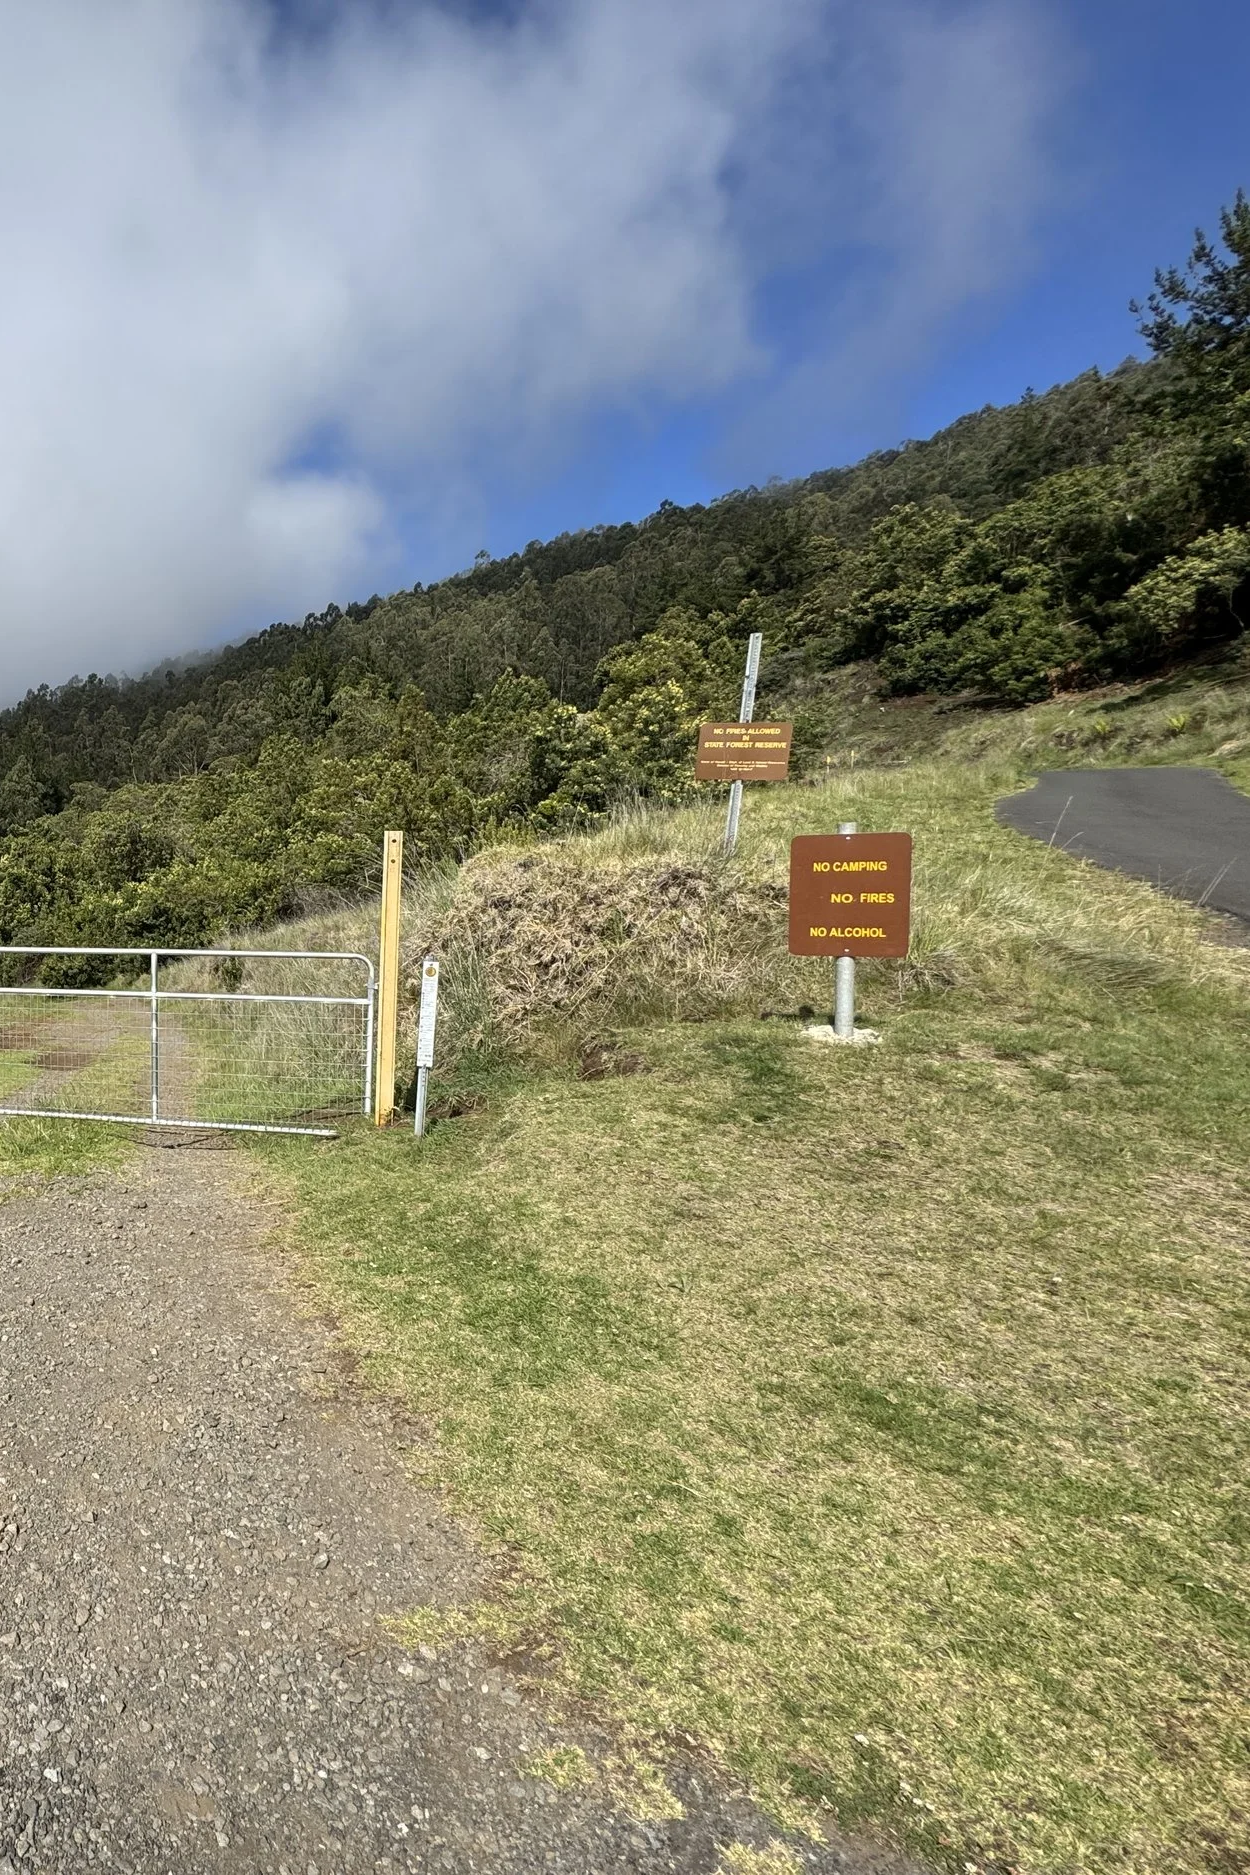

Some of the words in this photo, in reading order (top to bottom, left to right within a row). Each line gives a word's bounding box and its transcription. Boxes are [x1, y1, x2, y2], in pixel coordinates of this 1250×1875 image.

[813, 862, 830, 871] NO
[833, 861, 887, 871] CAMPING
[831, 894, 853, 903] NO
[860, 893, 894, 903] FIRES
[810, 928, 827, 937] NO
[829, 928, 886, 937] ALCOHOL
